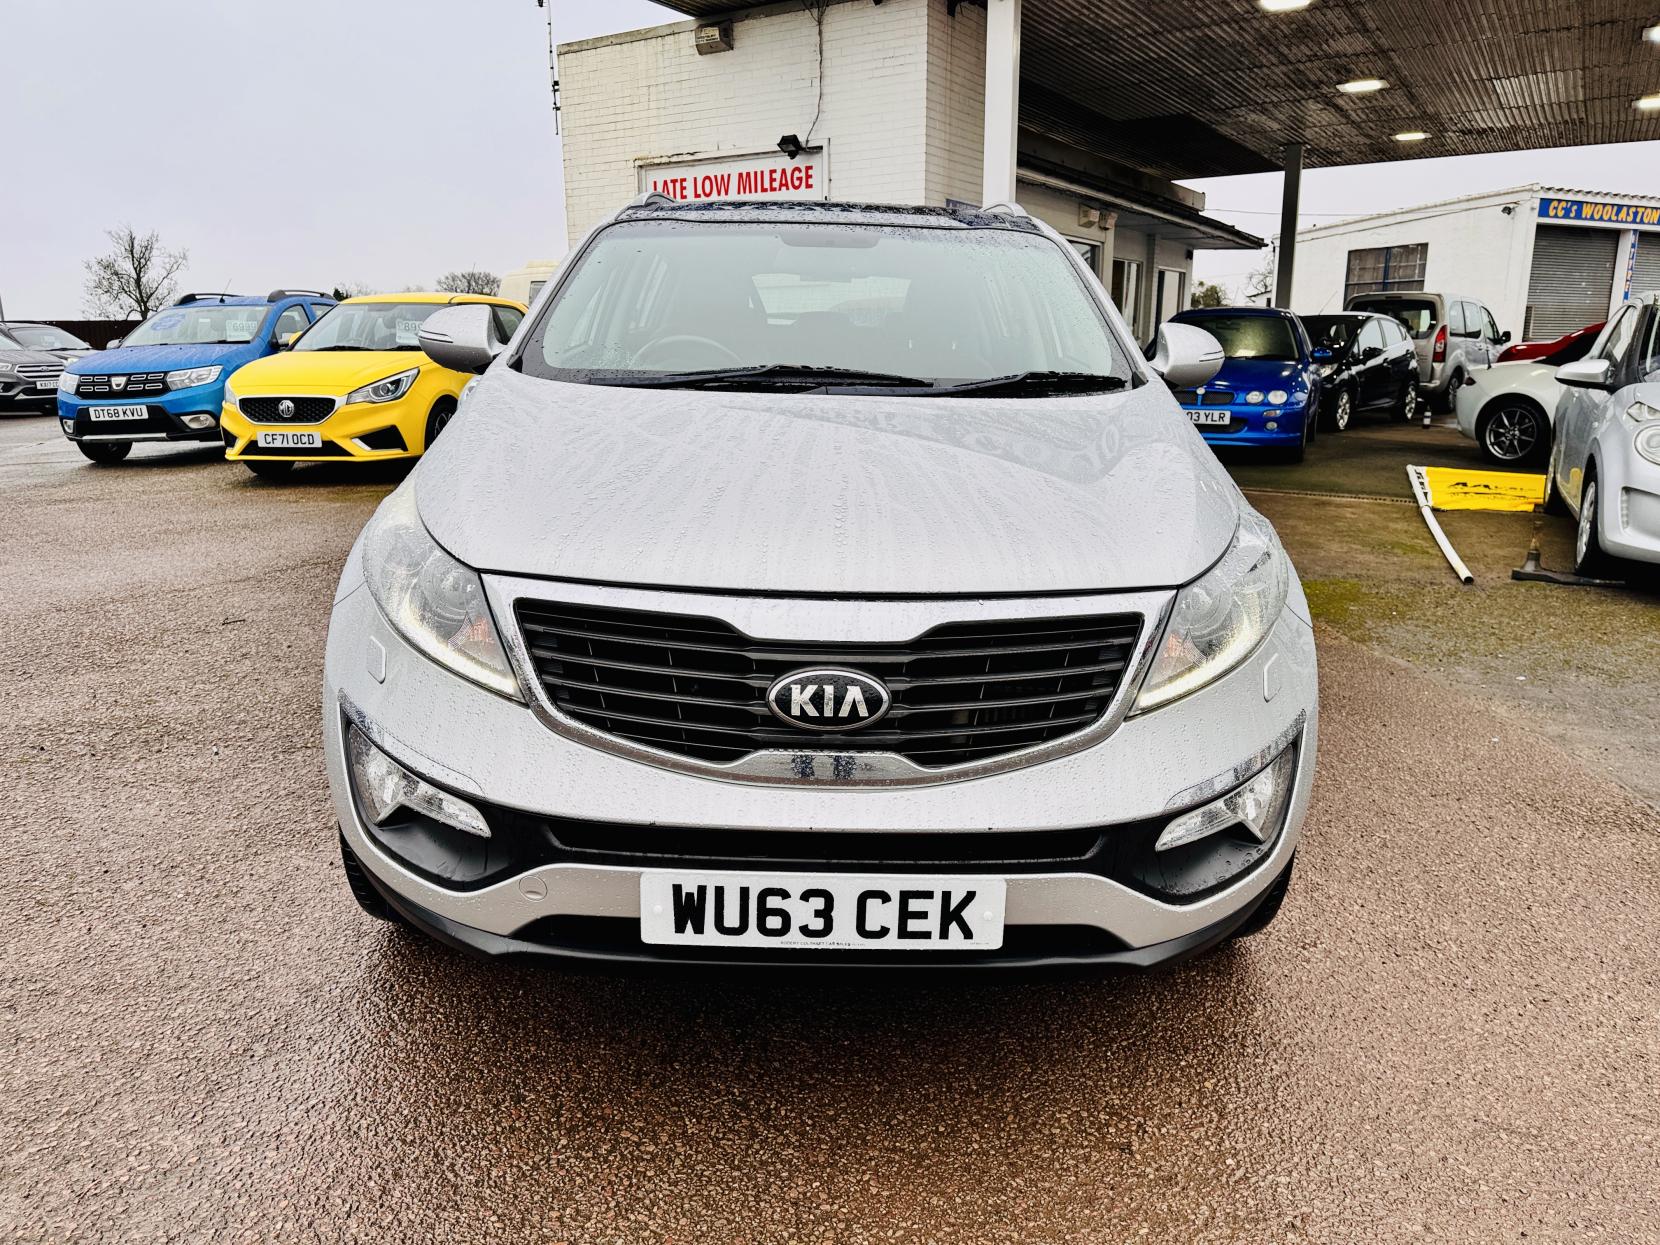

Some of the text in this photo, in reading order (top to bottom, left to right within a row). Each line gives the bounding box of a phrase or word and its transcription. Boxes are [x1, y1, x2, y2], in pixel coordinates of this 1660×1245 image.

[653, 165, 814, 200] LATE LOW MILEAGE
[1581, 202, 1660, 224] WOOLASTON
[93, 407, 143, 419] DT68 KVU
[279, 401, 294, 416] MG
[1204, 411, 1226, 423] YLR
[264, 433, 315, 445] CF71 OCD
[790, 684, 869, 717] KIA
[672, 883, 977, 940] WU63 CEK
